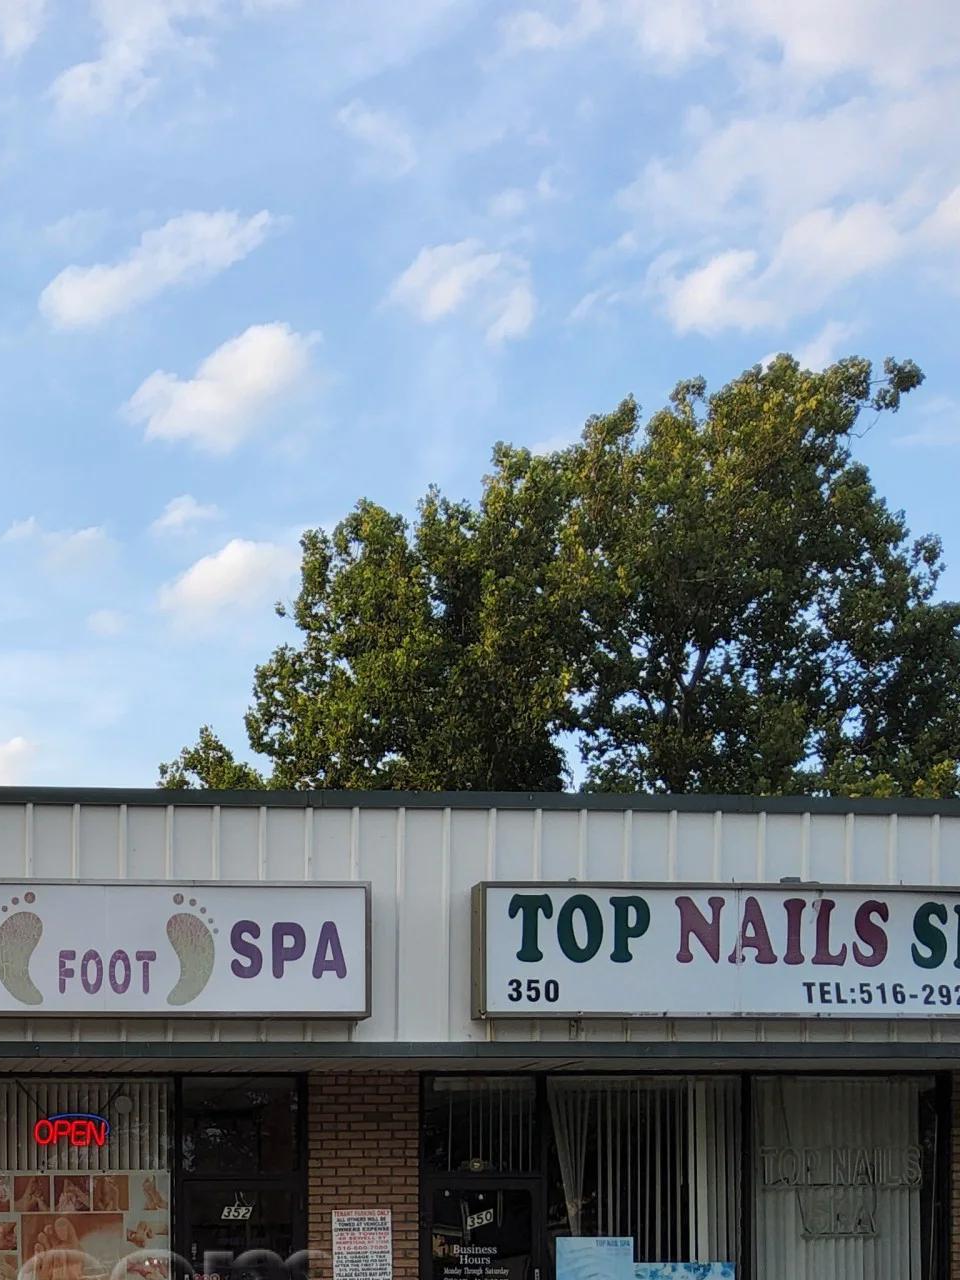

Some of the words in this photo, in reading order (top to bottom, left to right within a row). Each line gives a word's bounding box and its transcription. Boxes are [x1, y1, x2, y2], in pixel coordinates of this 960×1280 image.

[508, 894, 650, 963] TOP
[674, 896, 889, 968] NAILS
[911, 901, 960, 969] S
[58, 949, 157, 995] FOOT
[230, 919, 348, 979] SPA
[507, 979, 560, 1002] 350
[33, 1119, 106, 1147] OPEN
[759, 1146, 820, 1186] TOP
[830, 1144, 923, 1186] NAILS
[224, 1207, 251, 1219] 352
[469, 1211, 493, 1227] 350
[810, 1190, 876, 1234] SPA
[453, 1244, 498, 1255] Business
[459, 1255, 491, 1265] Hours
[443, 1266, 462, 1276] Monday
[484, 1266, 510, 1276] Saturday
